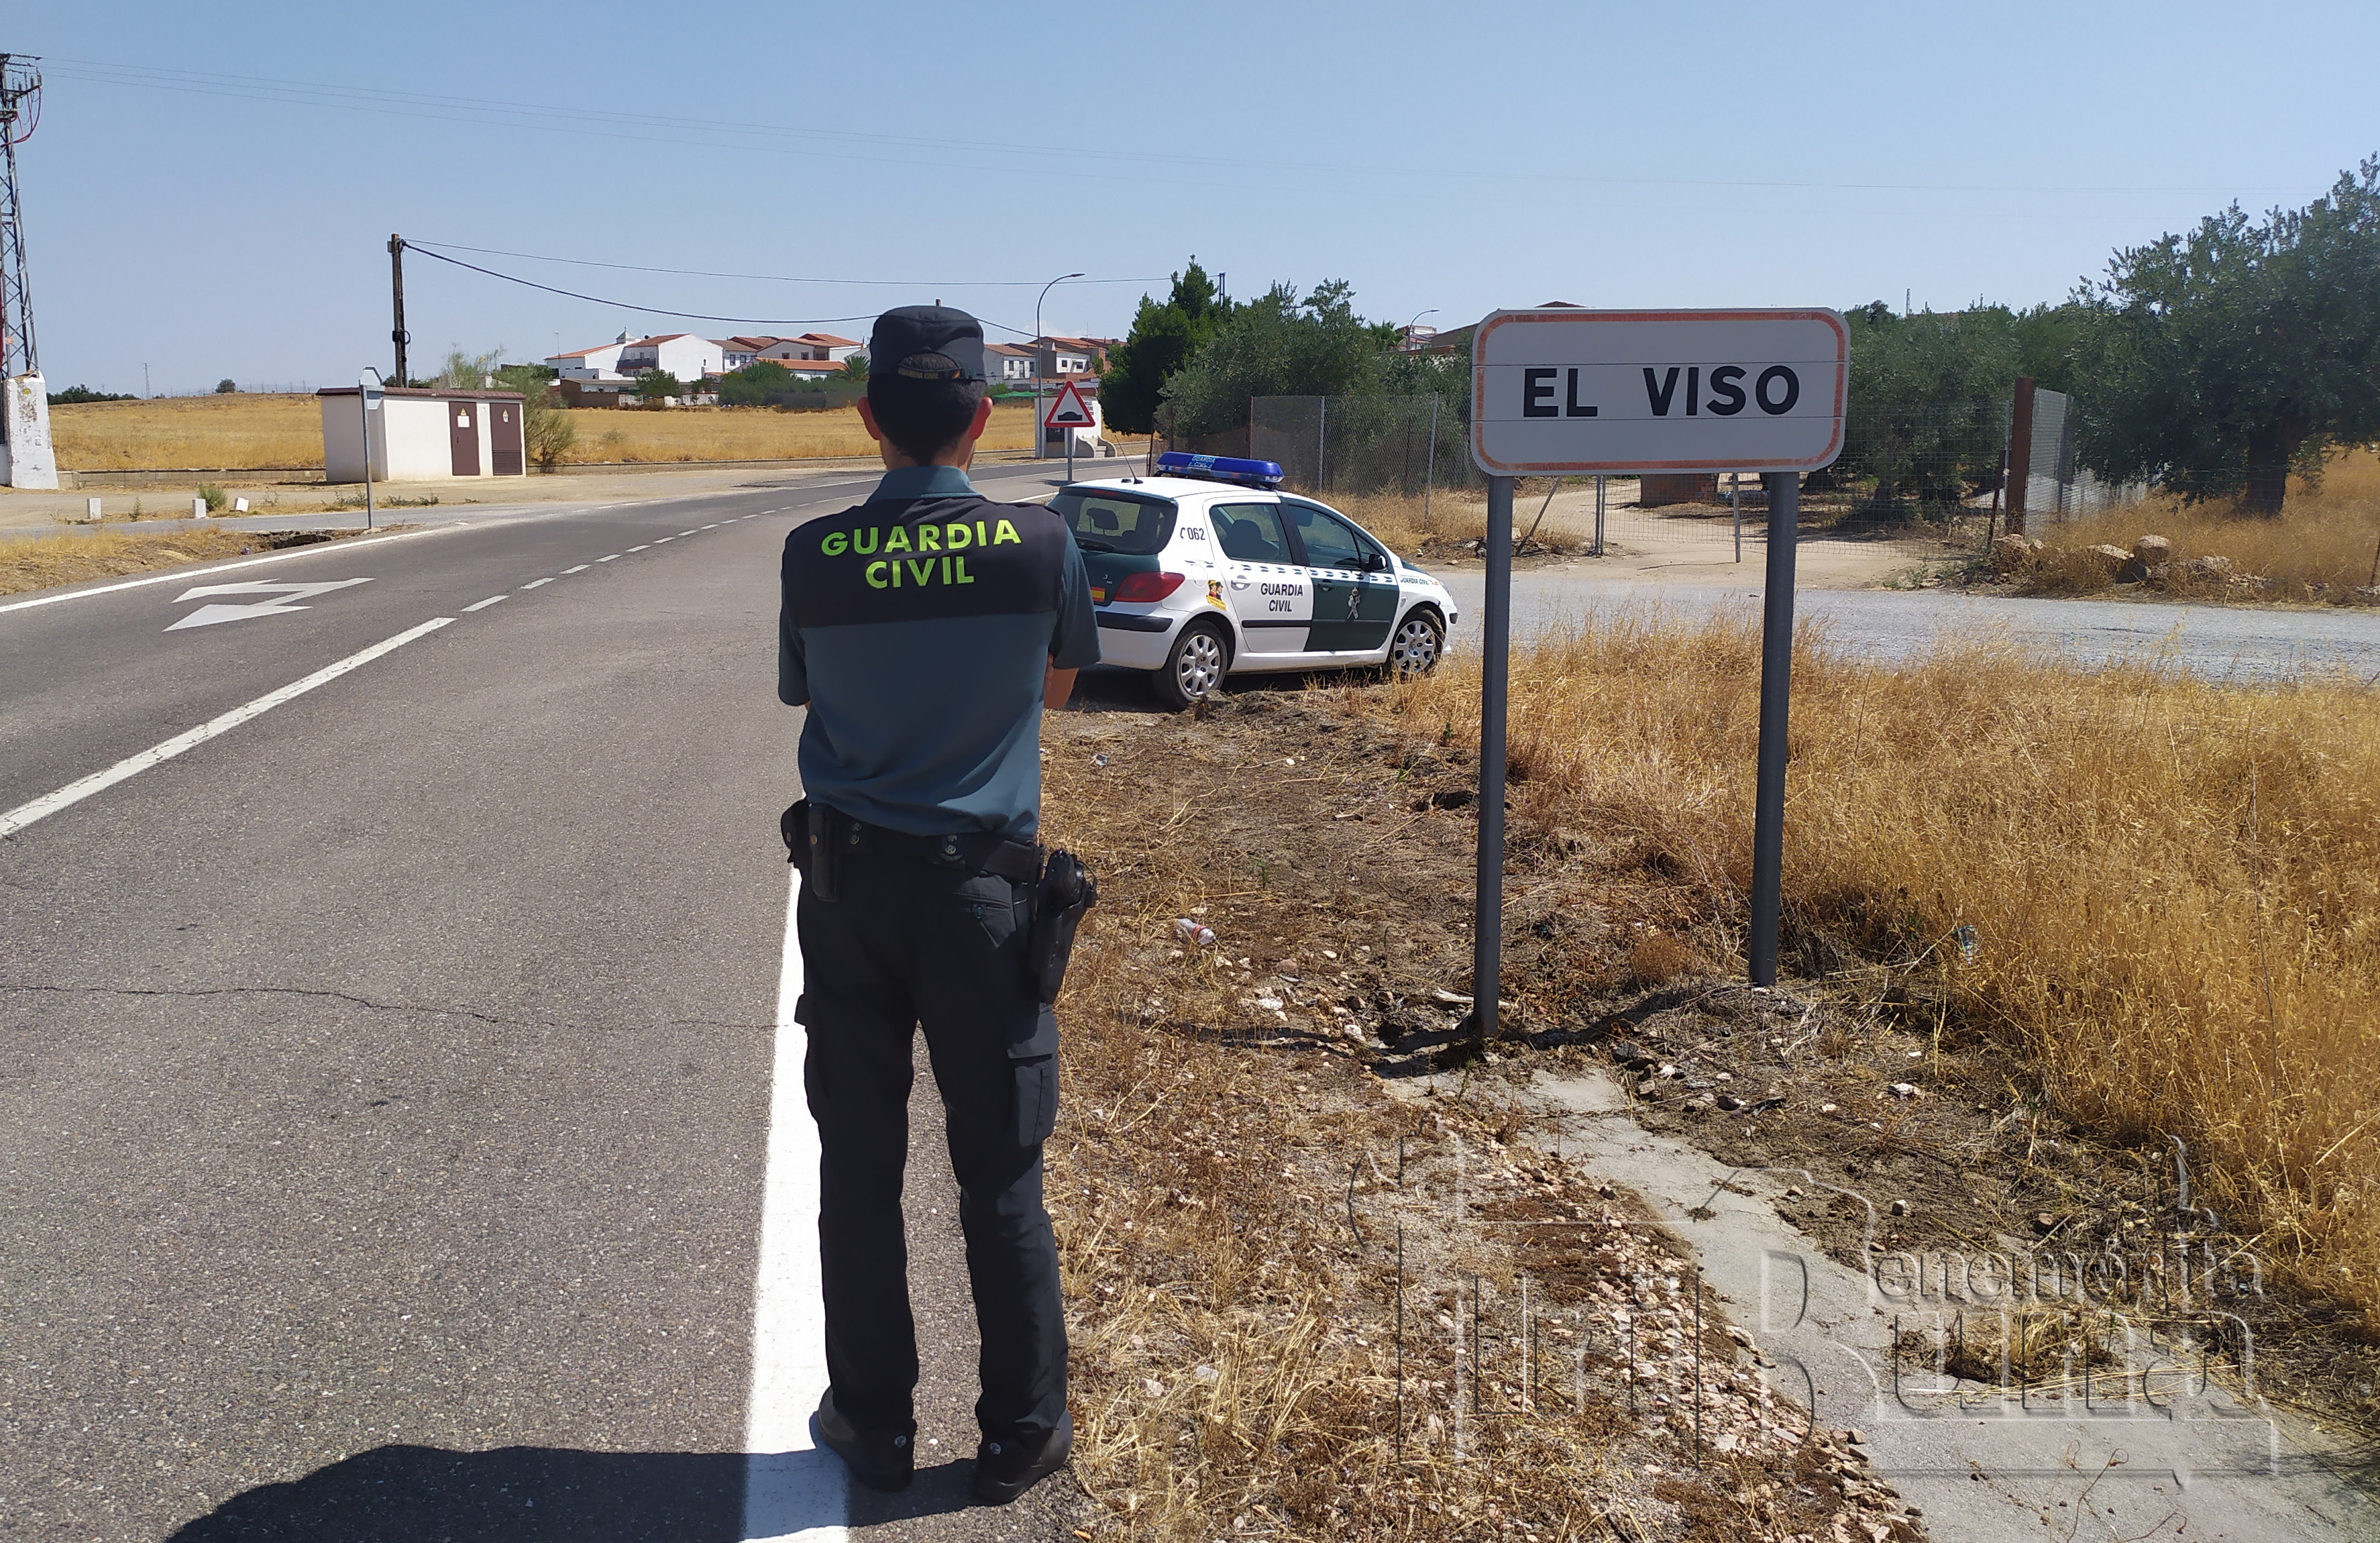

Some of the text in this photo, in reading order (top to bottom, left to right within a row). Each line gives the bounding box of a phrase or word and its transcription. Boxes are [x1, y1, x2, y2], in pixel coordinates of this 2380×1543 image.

[1523, 365, 1800, 417] EL VISO
[822, 519, 1022, 556] GUARDIA
[1187, 528, 1205, 540] 062
[866, 556, 975, 589] CIVIL
[1261, 583, 1303, 596] GUARDIA
[1268, 600, 1293, 612] CIVIL
